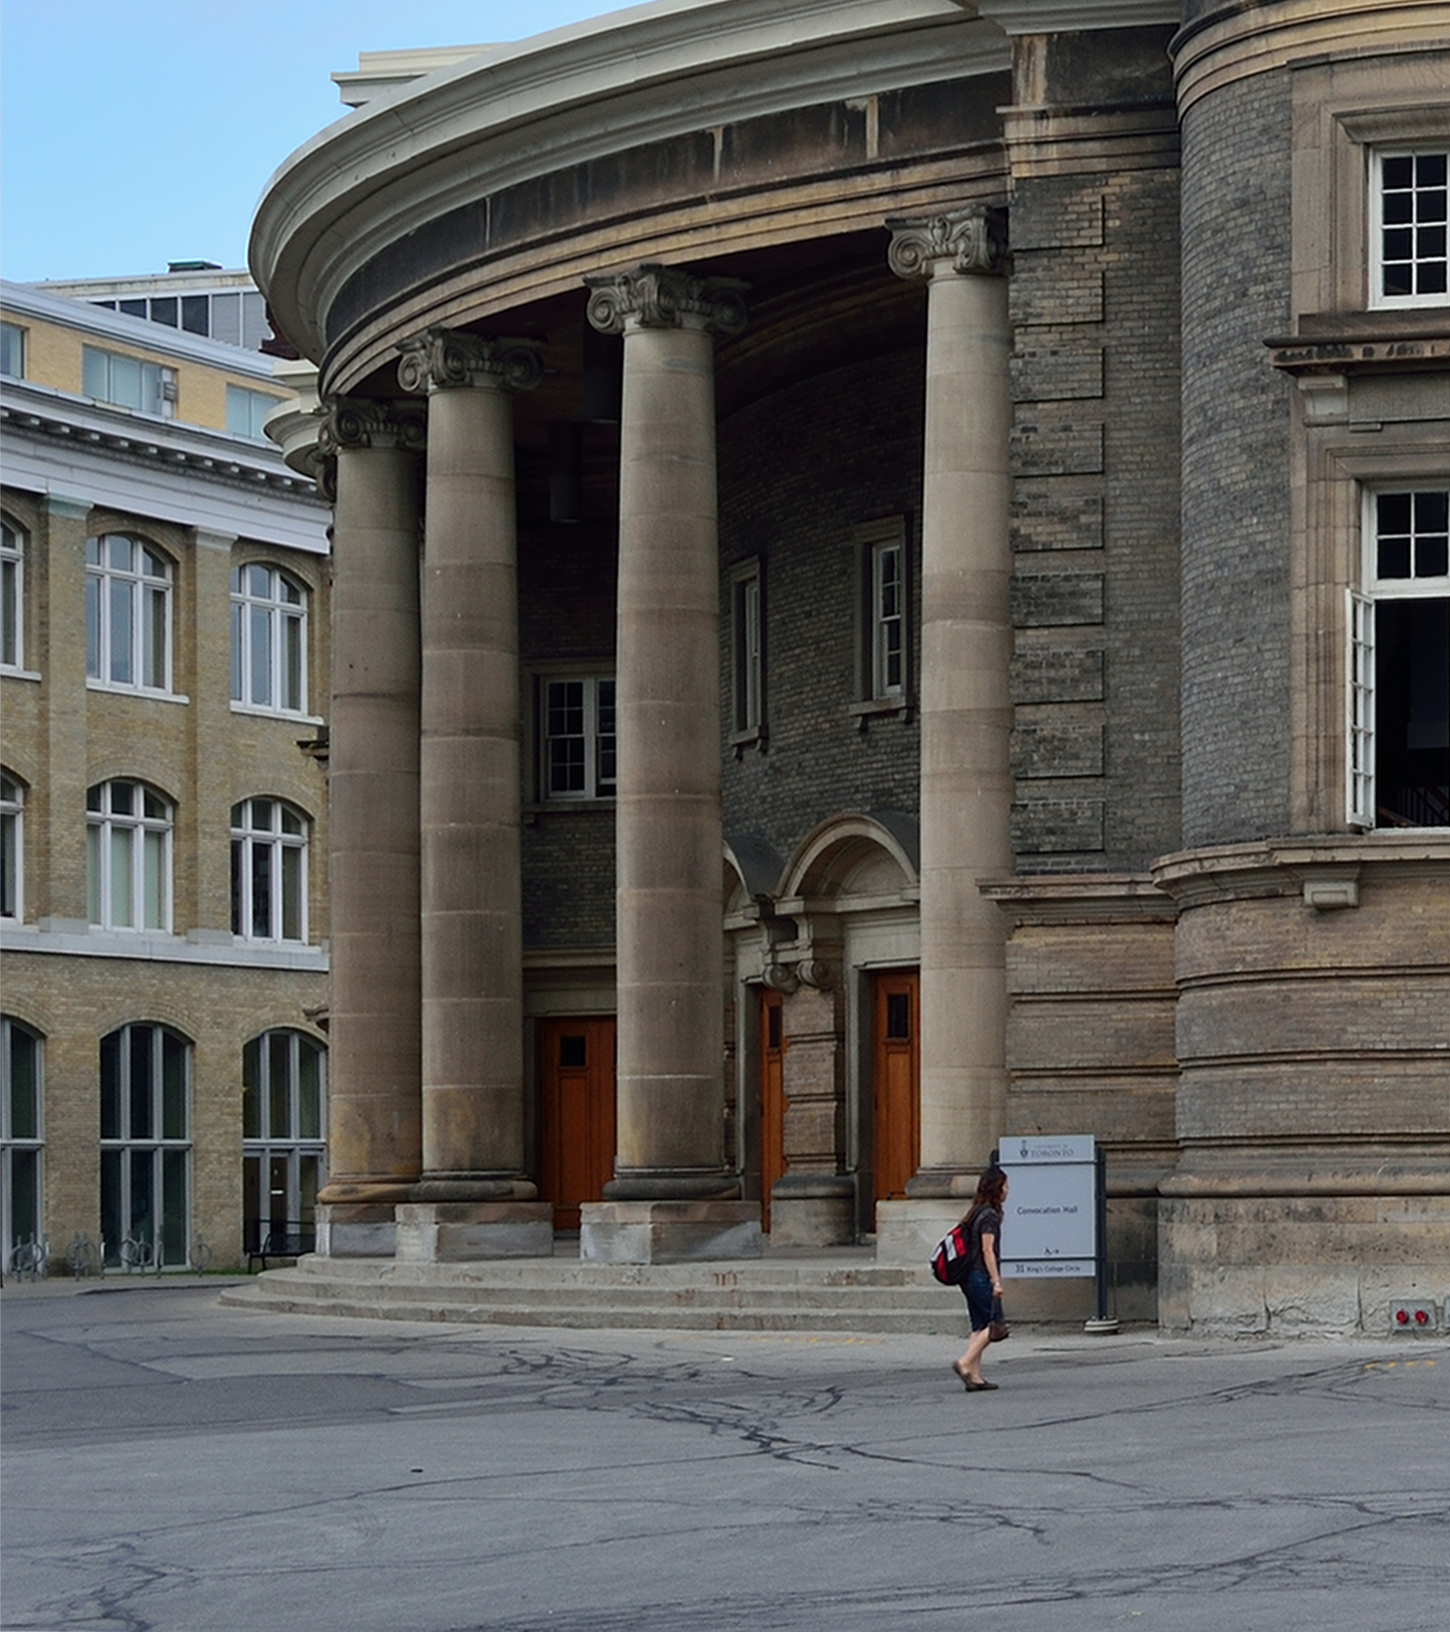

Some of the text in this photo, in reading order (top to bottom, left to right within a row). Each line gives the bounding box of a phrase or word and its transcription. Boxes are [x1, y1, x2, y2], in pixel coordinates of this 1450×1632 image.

[1031, 1148, 1074, 1158] TORONTO
[1016, 1205, 1078, 1215] Convocation Hall
[1015, 1264, 1025, 1274] 31
